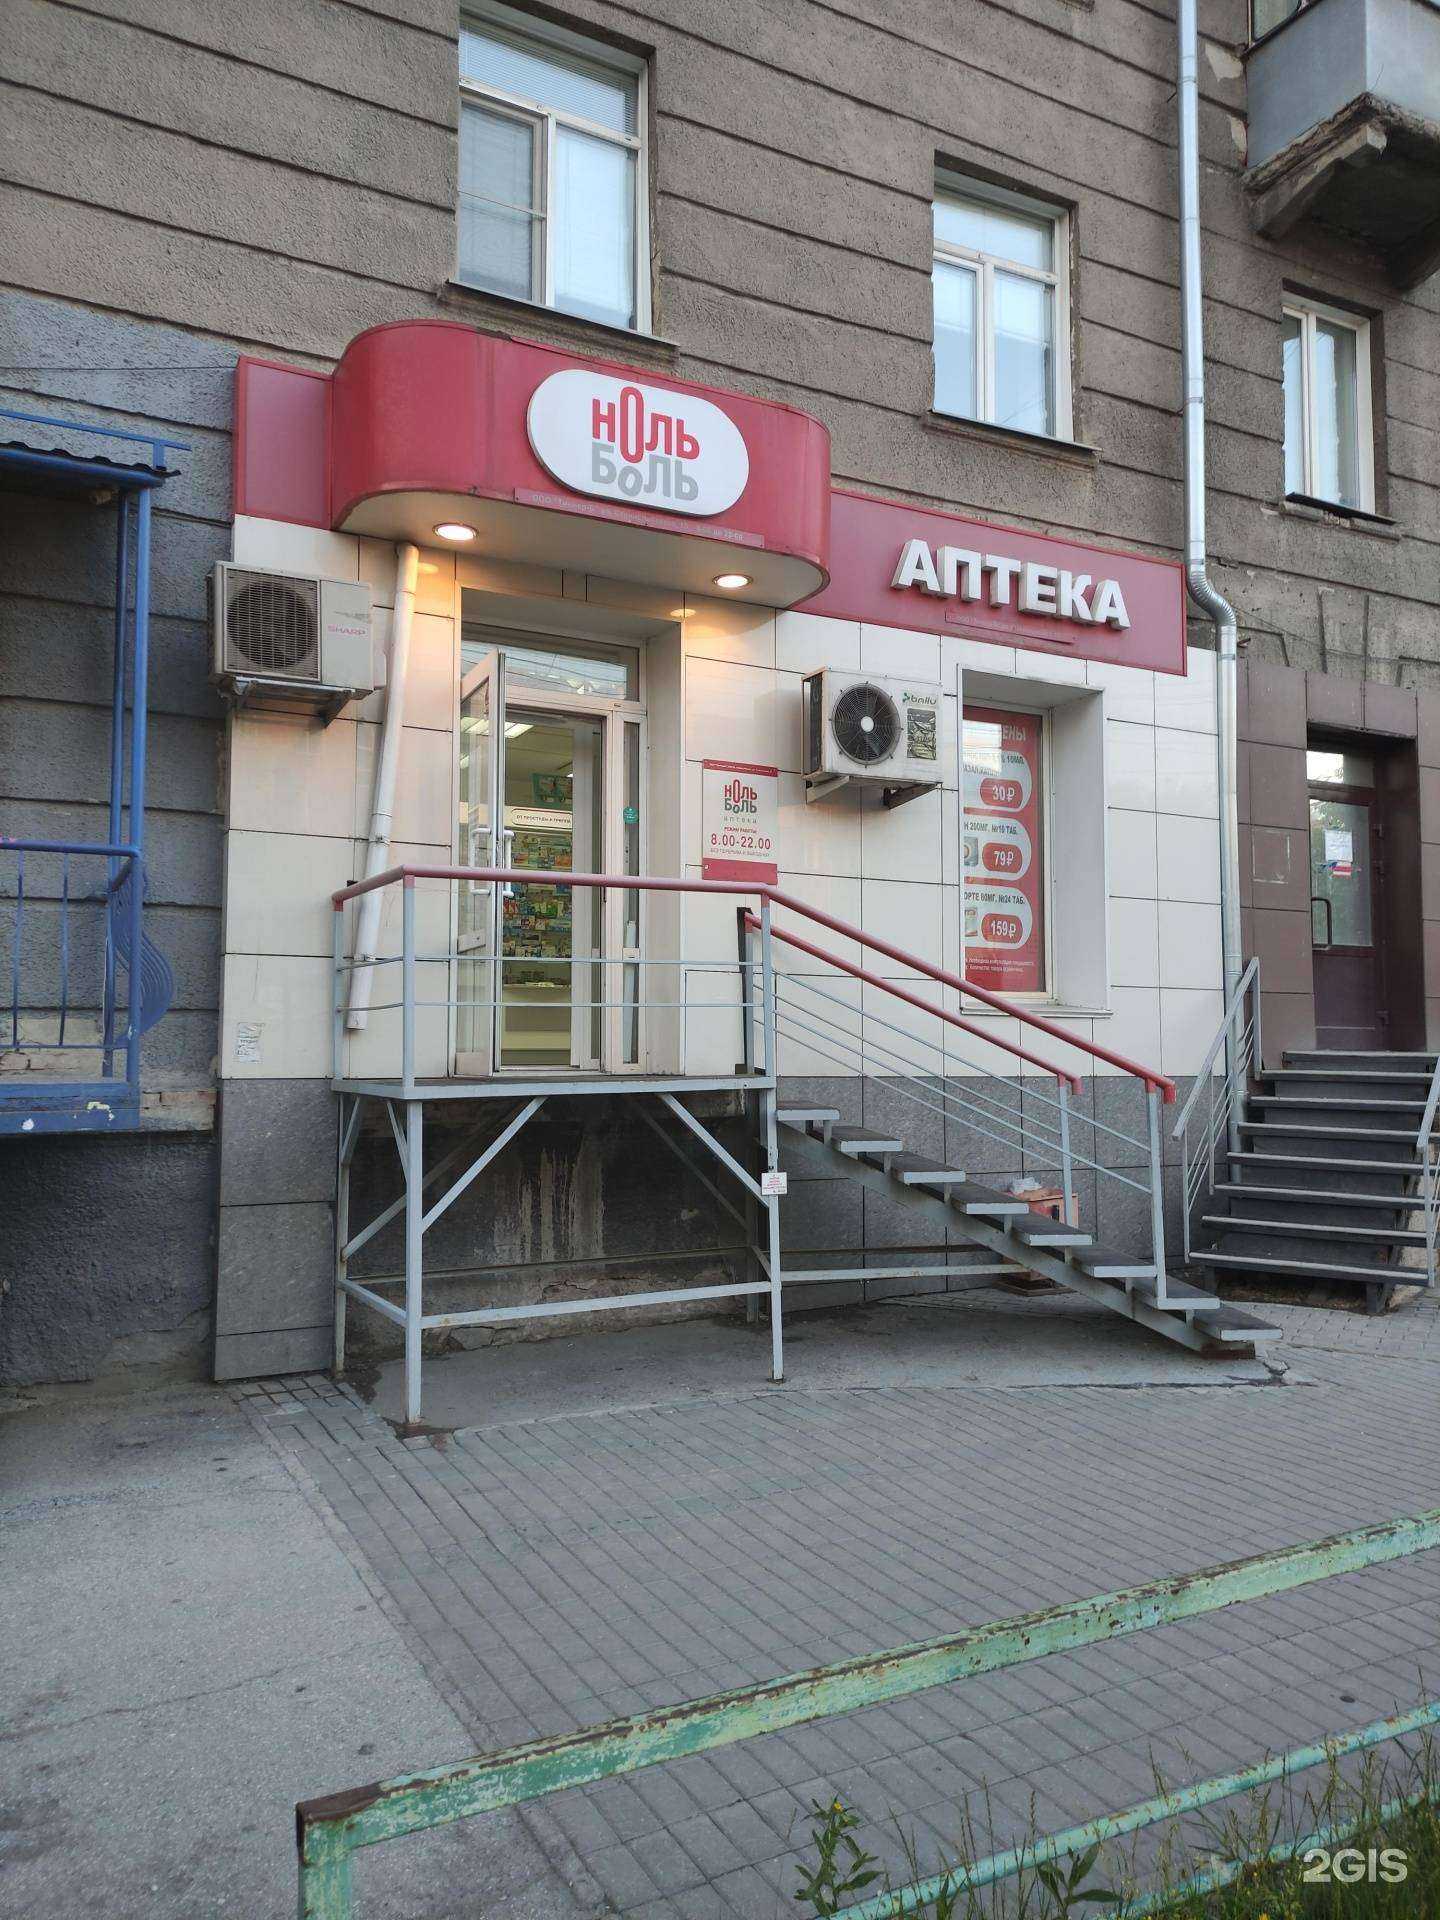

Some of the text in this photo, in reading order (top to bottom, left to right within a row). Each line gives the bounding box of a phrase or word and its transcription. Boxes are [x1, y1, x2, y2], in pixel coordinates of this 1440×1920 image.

[891, 539, 1131, 631] АПТЕКА
[328, 624, 366, 635] SHARP
[711, 833, 771, 850] 8.00-22.00
